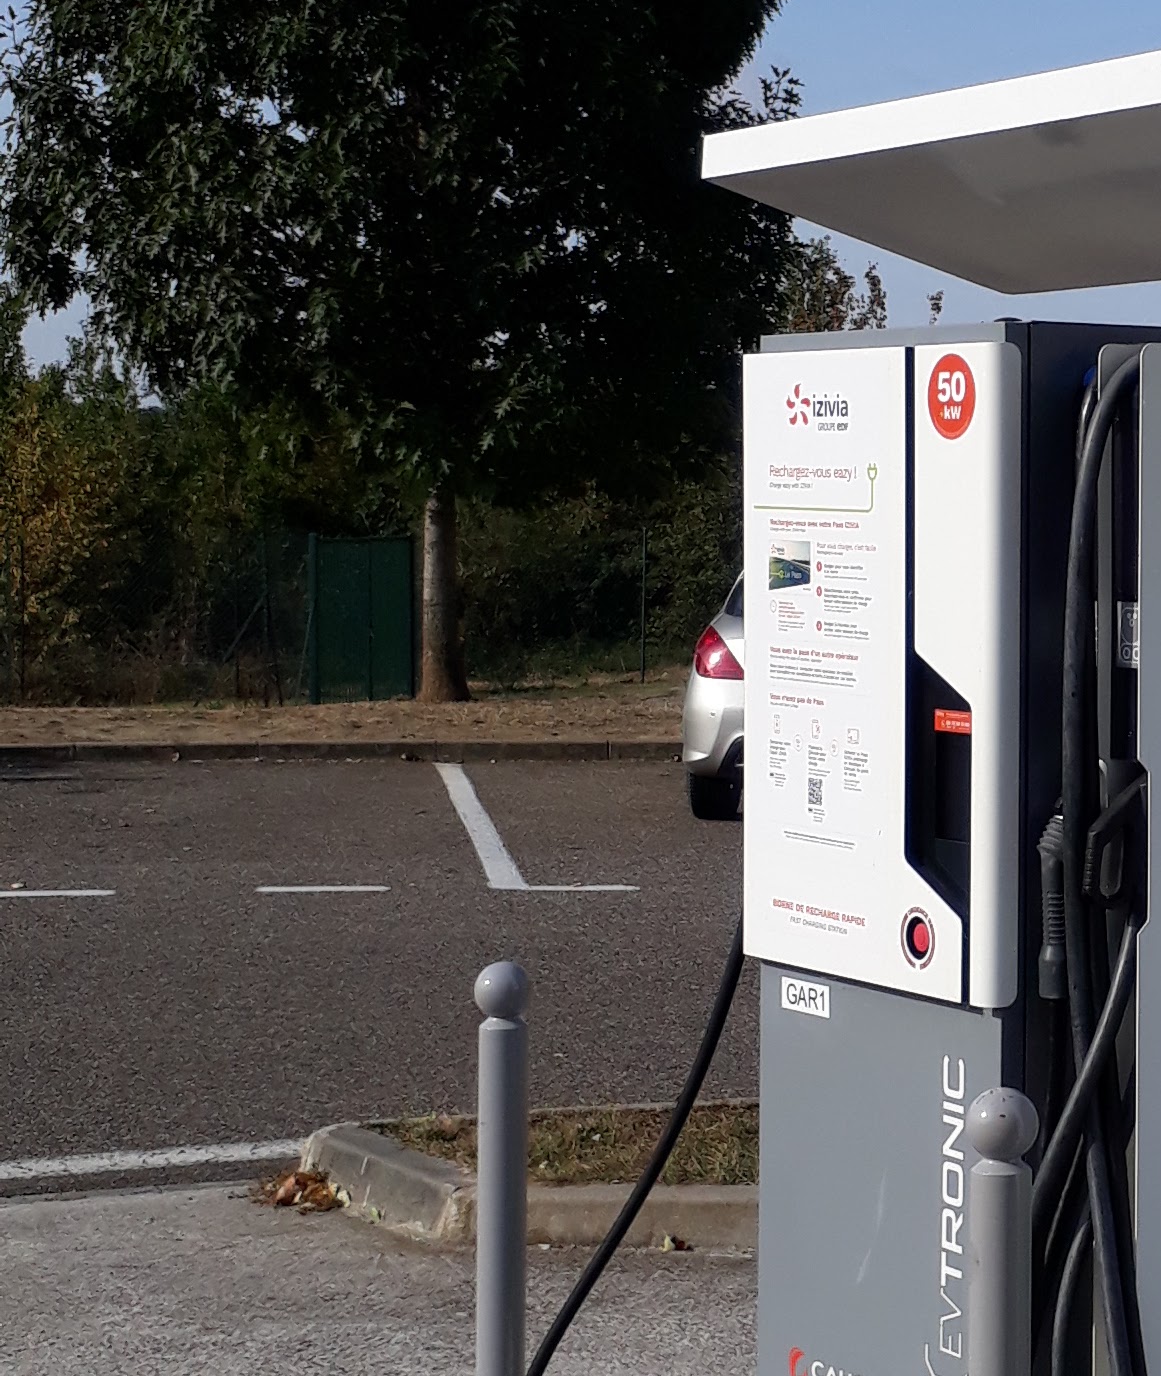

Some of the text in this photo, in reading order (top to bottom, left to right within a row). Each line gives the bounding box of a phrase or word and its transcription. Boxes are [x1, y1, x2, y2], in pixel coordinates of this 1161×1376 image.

[937, 370, 966, 403] 50
[812, 393, 849, 417] izivia
[943, 405, 962, 420] kW
[786, 982, 826, 1012] GAR1
[939, 1054, 965, 1360] EVTRONIC
